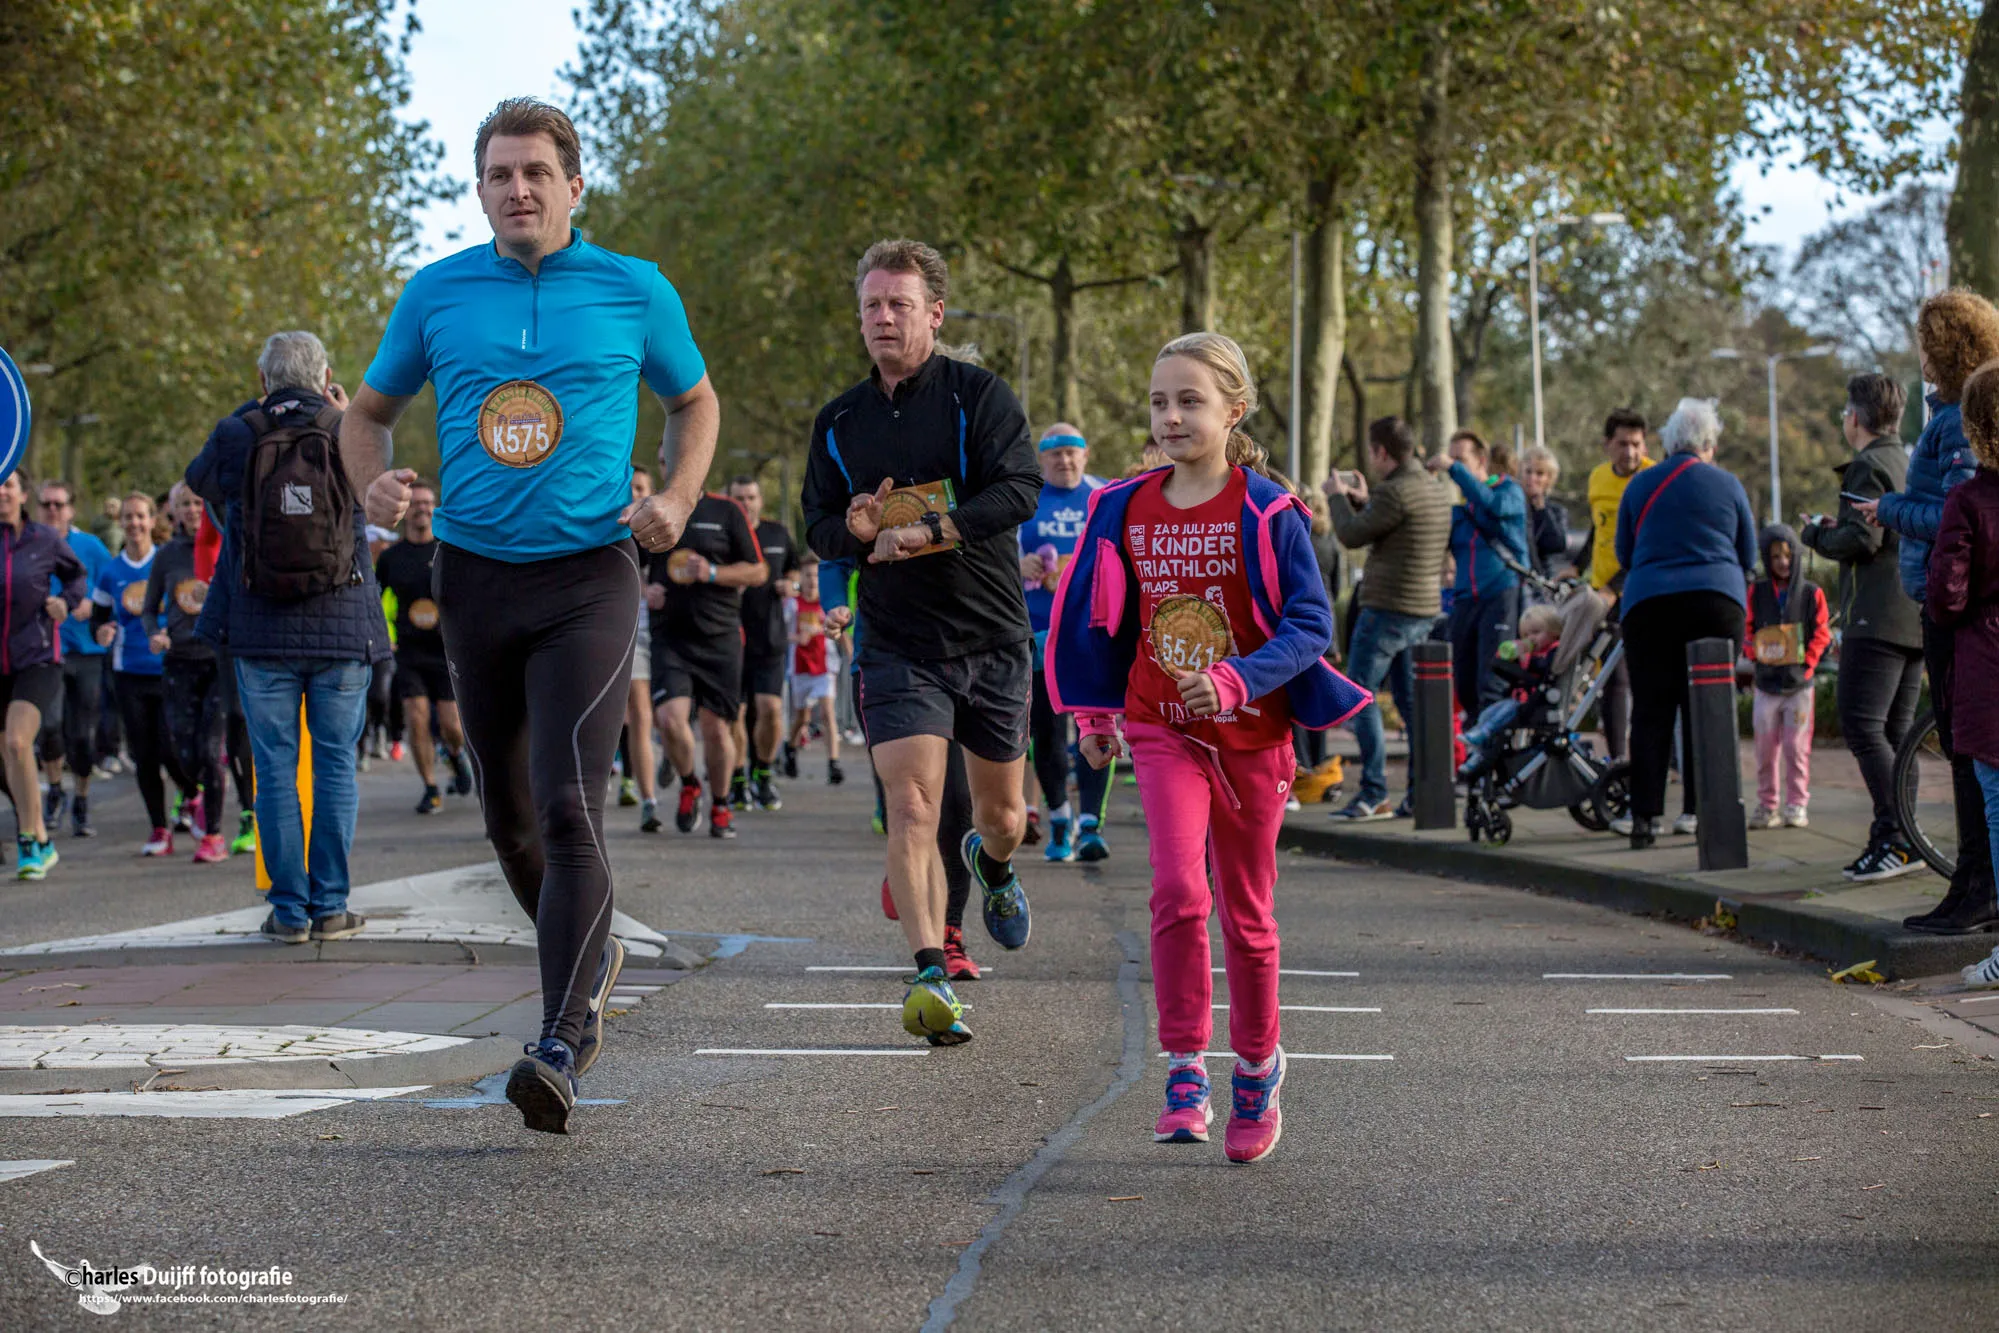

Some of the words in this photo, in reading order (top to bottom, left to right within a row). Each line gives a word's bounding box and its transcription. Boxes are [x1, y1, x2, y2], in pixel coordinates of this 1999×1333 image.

[493, 423, 550, 454] K575
[1182, 523, 1205, 535] JULI
[1208, 522, 1236, 534] 2016
[1152, 535, 1236, 556] KINDER
[1136, 558, 1236, 578] TRIATHLON
[1162, 633, 1215, 671] 5541
[1212, 714, 1238, 723] Vopak
